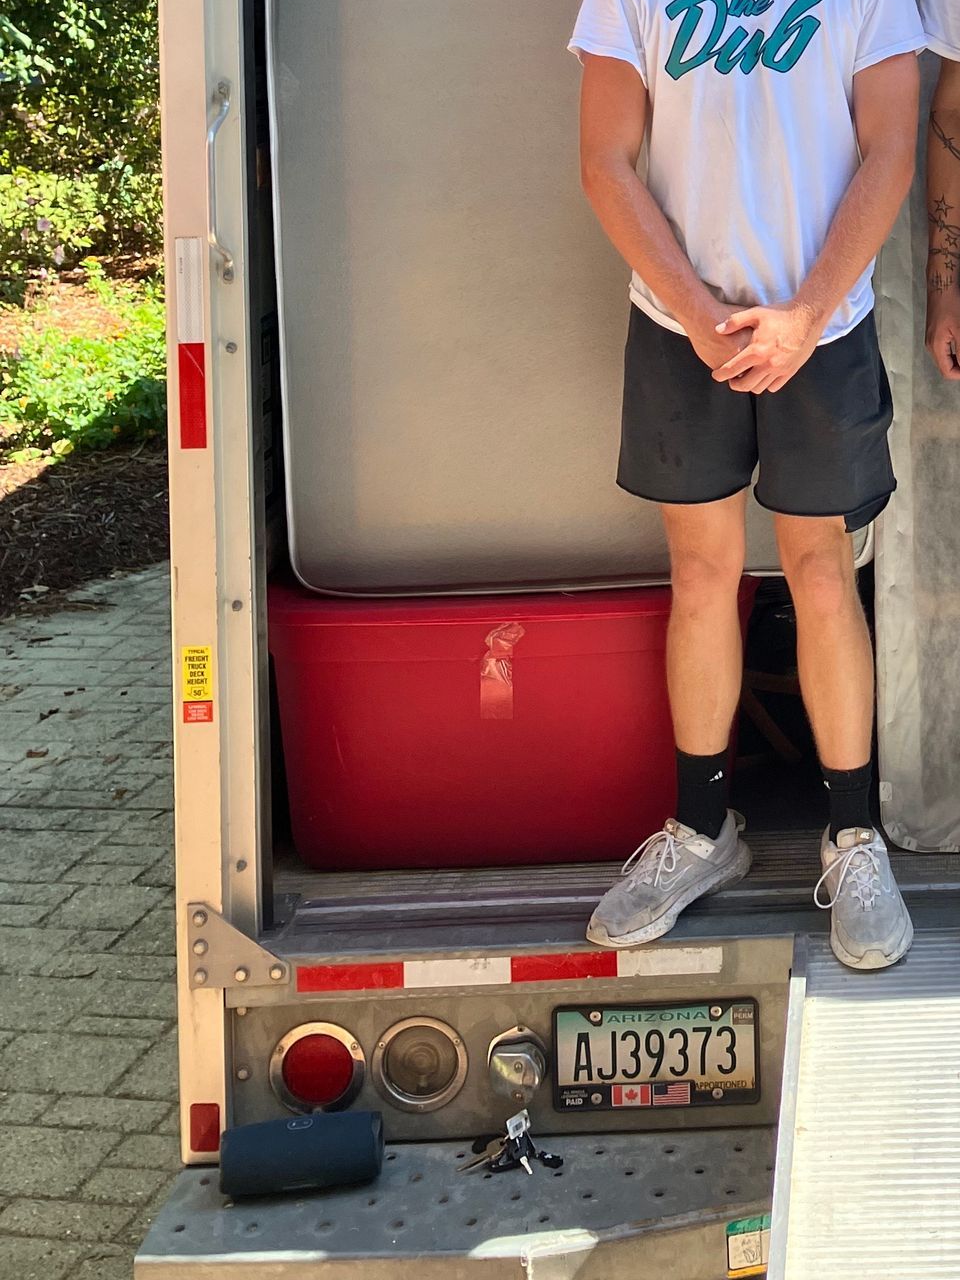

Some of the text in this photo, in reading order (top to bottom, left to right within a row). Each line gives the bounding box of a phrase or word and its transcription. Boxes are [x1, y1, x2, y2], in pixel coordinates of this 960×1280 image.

[189, 670, 205, 678] DECK
[606, 1010, 708, 1024] ARIZONA
[573, 1026, 737, 1082] AJ39373
[565, 1097, 583, 1106] PAID
